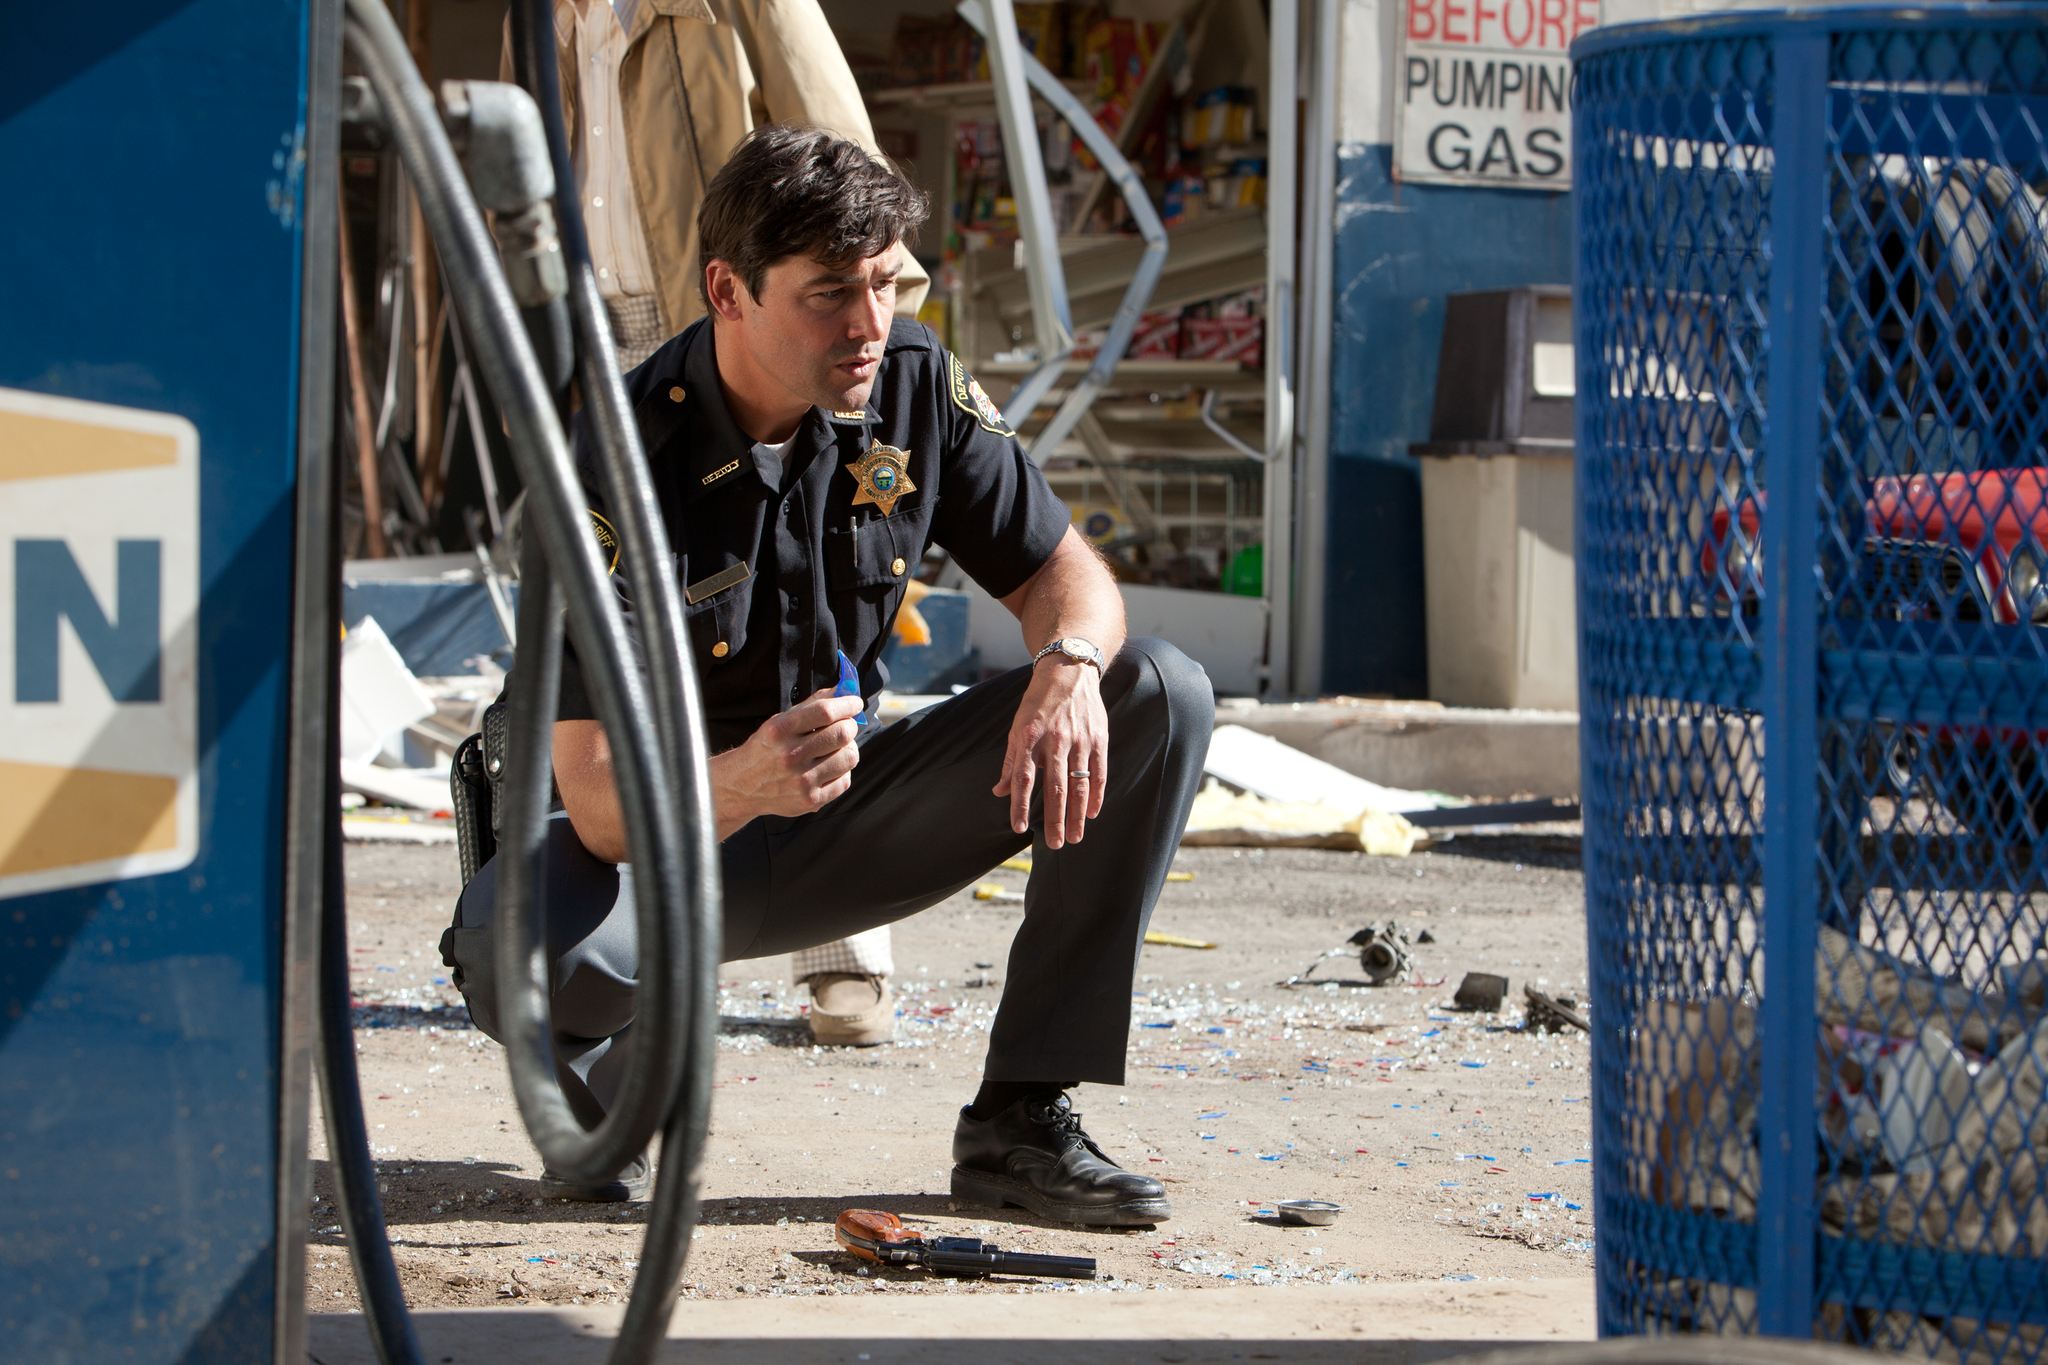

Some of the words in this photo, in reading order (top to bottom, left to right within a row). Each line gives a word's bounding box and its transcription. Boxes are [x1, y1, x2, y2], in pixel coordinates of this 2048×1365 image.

[1406, 57, 1578, 113] PUMPIN
[1427, 122, 1564, 177] GAS
[702, 459, 739, 485] DEPUTY
[865, 446, 892, 459] DEPUTY
[15, 537, 162, 704] N
